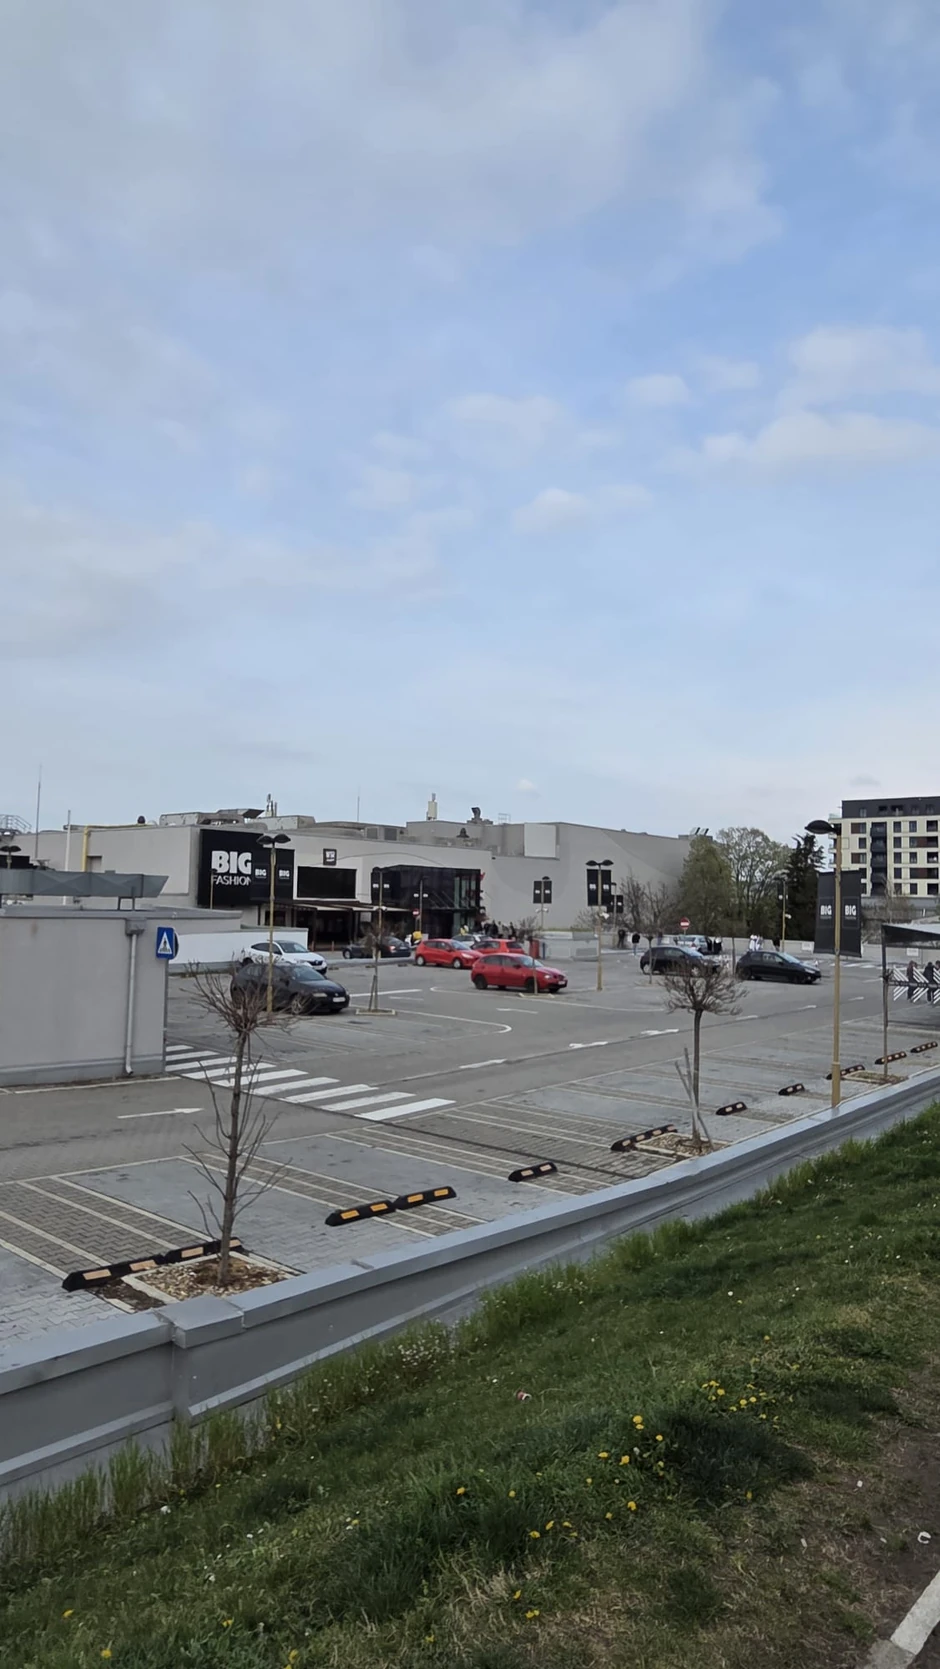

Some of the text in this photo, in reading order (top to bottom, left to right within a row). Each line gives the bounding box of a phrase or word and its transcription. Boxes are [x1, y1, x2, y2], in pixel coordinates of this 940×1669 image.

[211, 850, 252, 875] BIG
[255, 868, 267, 877] BIG
[279, 869, 290, 877] BIG
[820, 905, 832, 915] BIG
[845, 905, 857, 916] BIG
